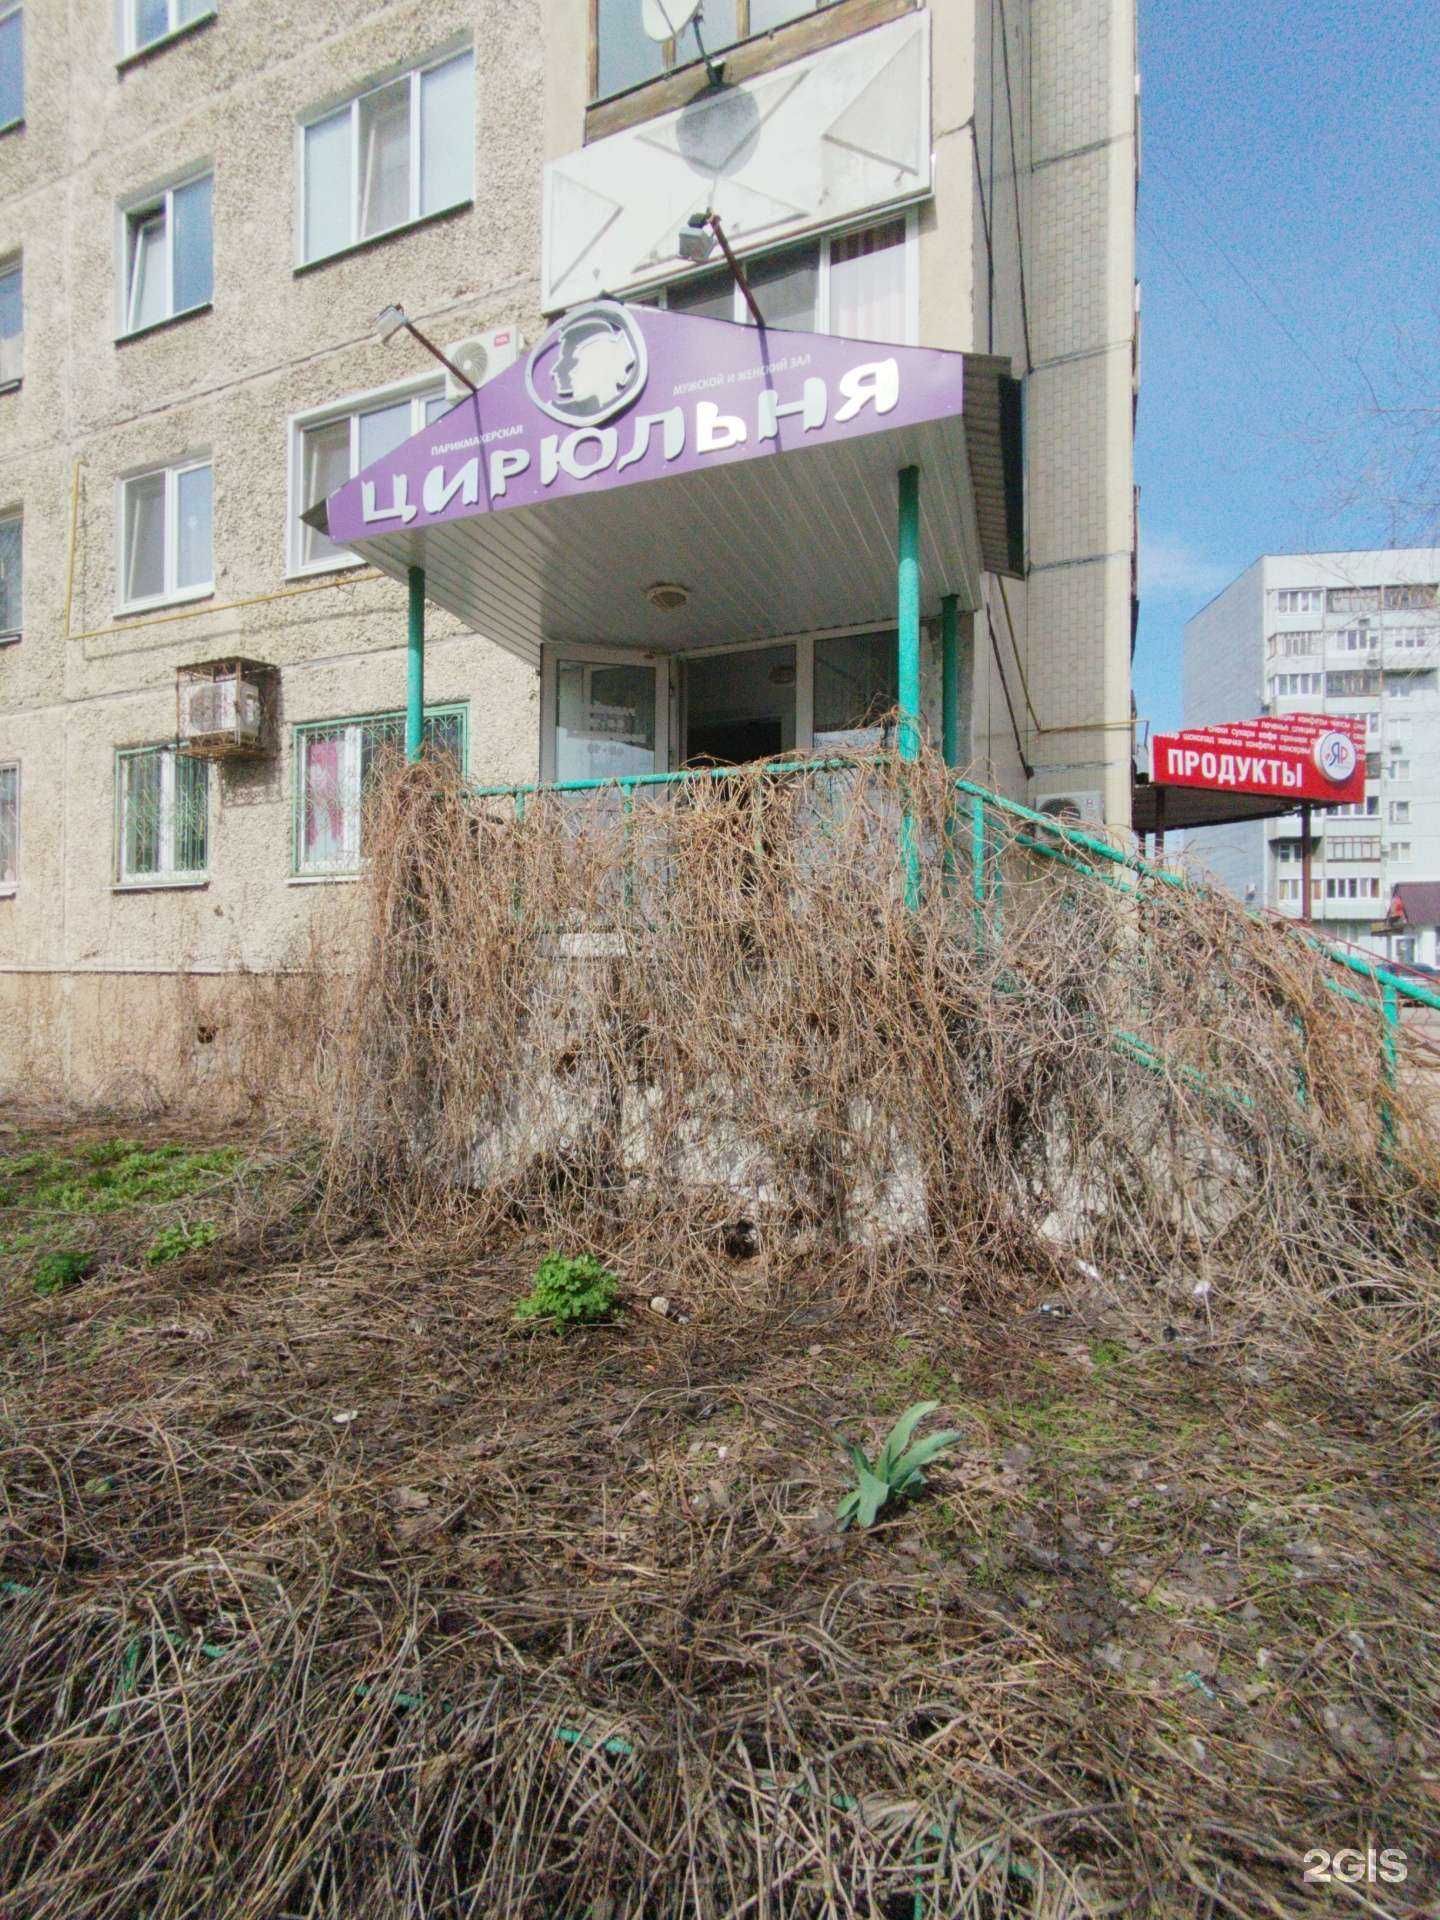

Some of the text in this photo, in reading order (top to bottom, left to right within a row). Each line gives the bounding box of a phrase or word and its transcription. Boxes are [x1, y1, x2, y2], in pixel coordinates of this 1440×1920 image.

[672, 353, 811, 396] МУЖСКОЙ И ЖЕНСКИЙ ЗАЛ
[361, 357, 900, 524] ЦИРЮЛЬНЯ
[431, 424, 524, 456] ПАРИКМАХЕРСКАЯ
[1168, 748, 1303, 787] ПРОДУКТЫ
